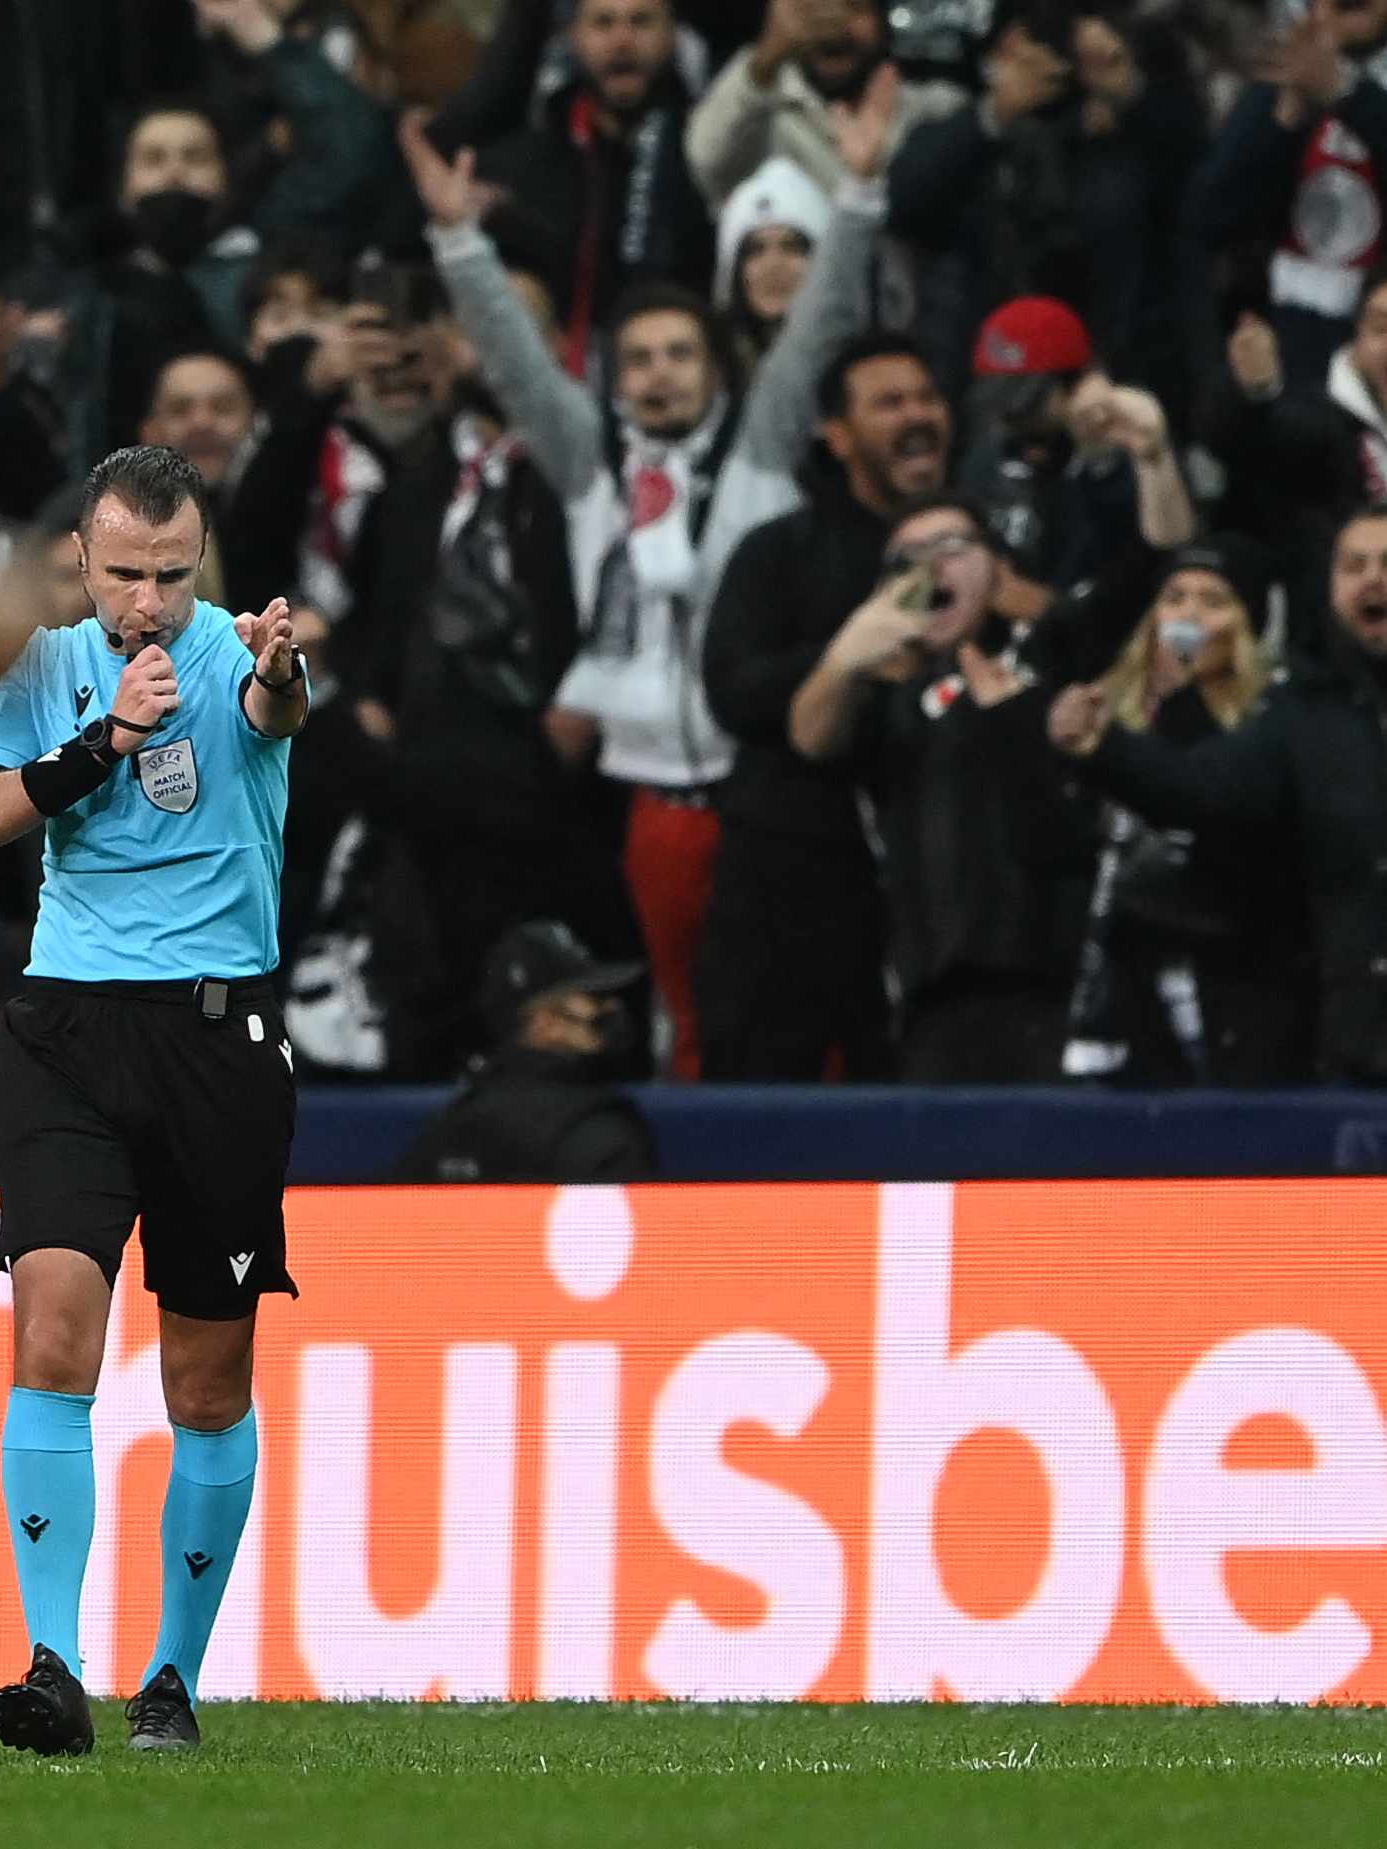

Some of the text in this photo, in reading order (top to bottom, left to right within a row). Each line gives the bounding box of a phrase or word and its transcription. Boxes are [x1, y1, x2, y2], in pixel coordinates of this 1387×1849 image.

[149, 751, 181, 770] UEFA
[154, 771, 185, 787] MATCH
[153, 782, 193, 799] OFFICIAL
